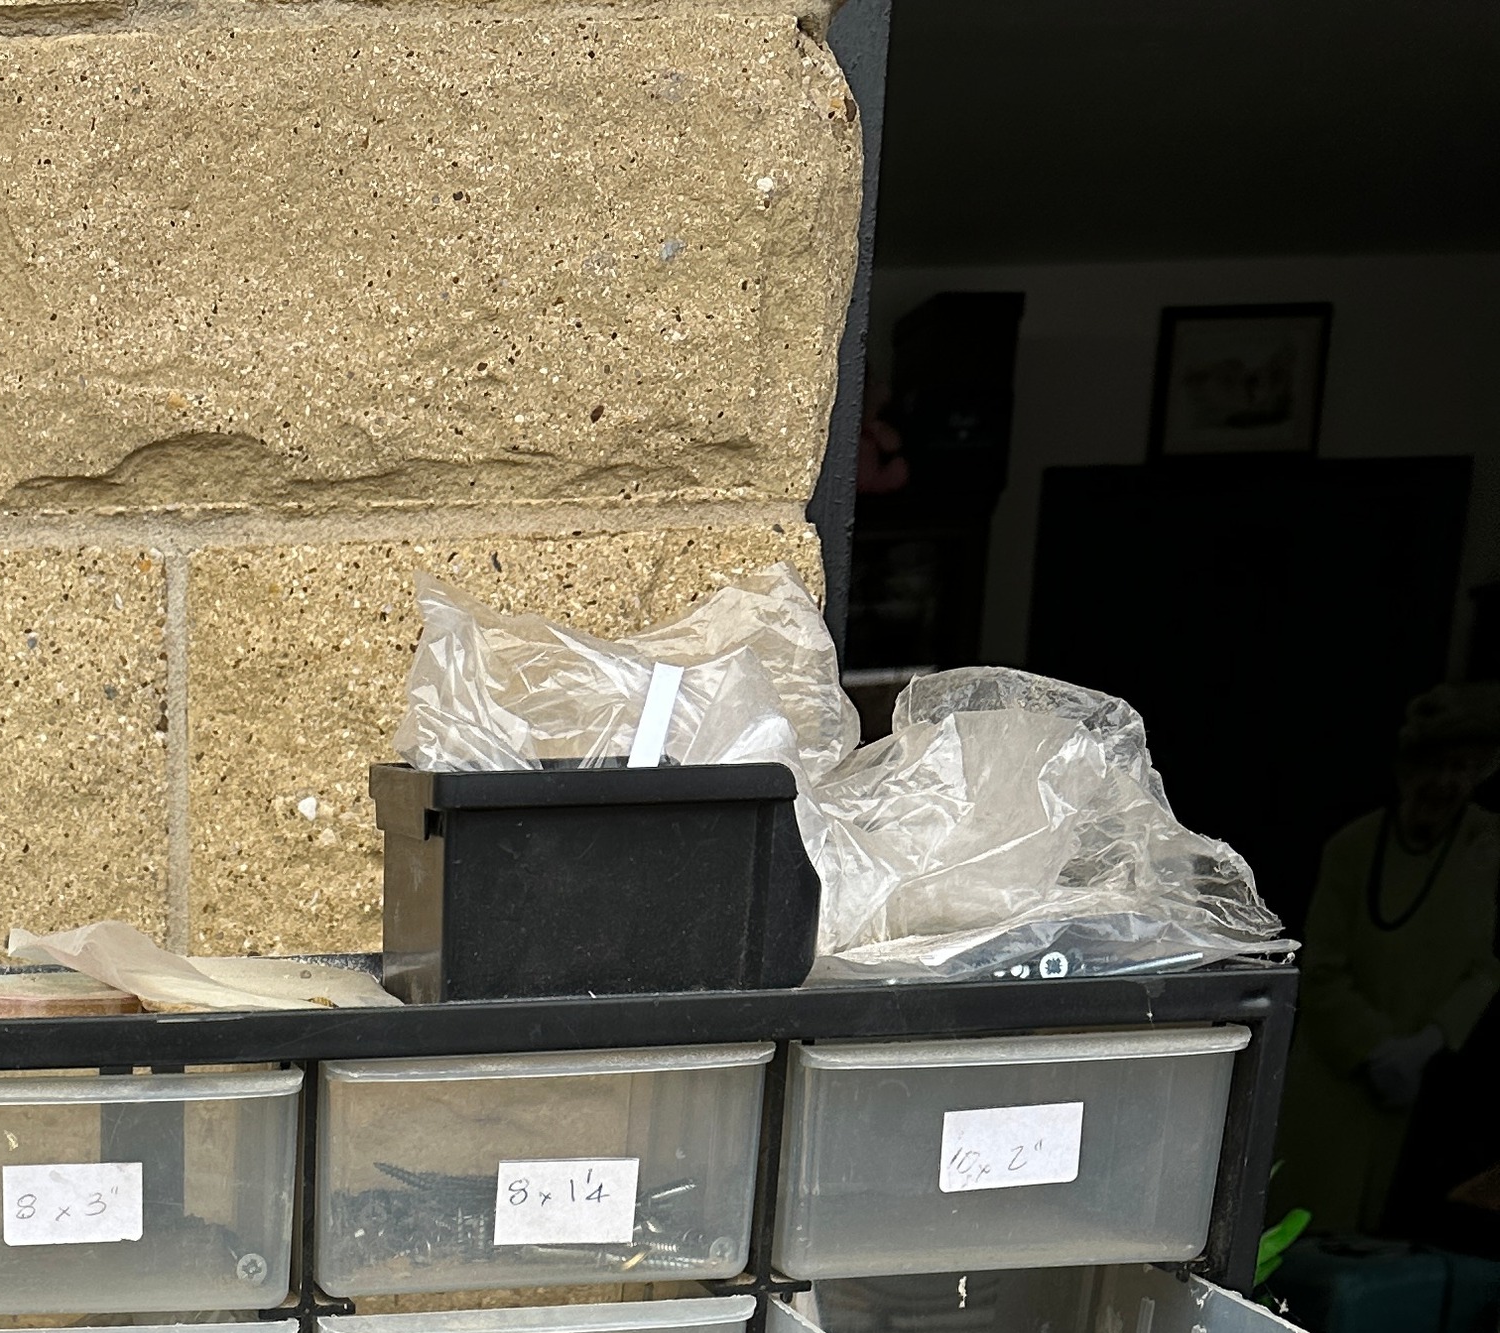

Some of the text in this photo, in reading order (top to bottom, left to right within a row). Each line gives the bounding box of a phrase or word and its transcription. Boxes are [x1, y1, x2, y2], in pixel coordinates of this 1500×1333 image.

[1007, 1138, 1043, 1171] 2"
[15, 1193, 38, 1220] 8
[85, 1185, 119, 1217] 3"
[508, 1179, 530, 1206] 8
